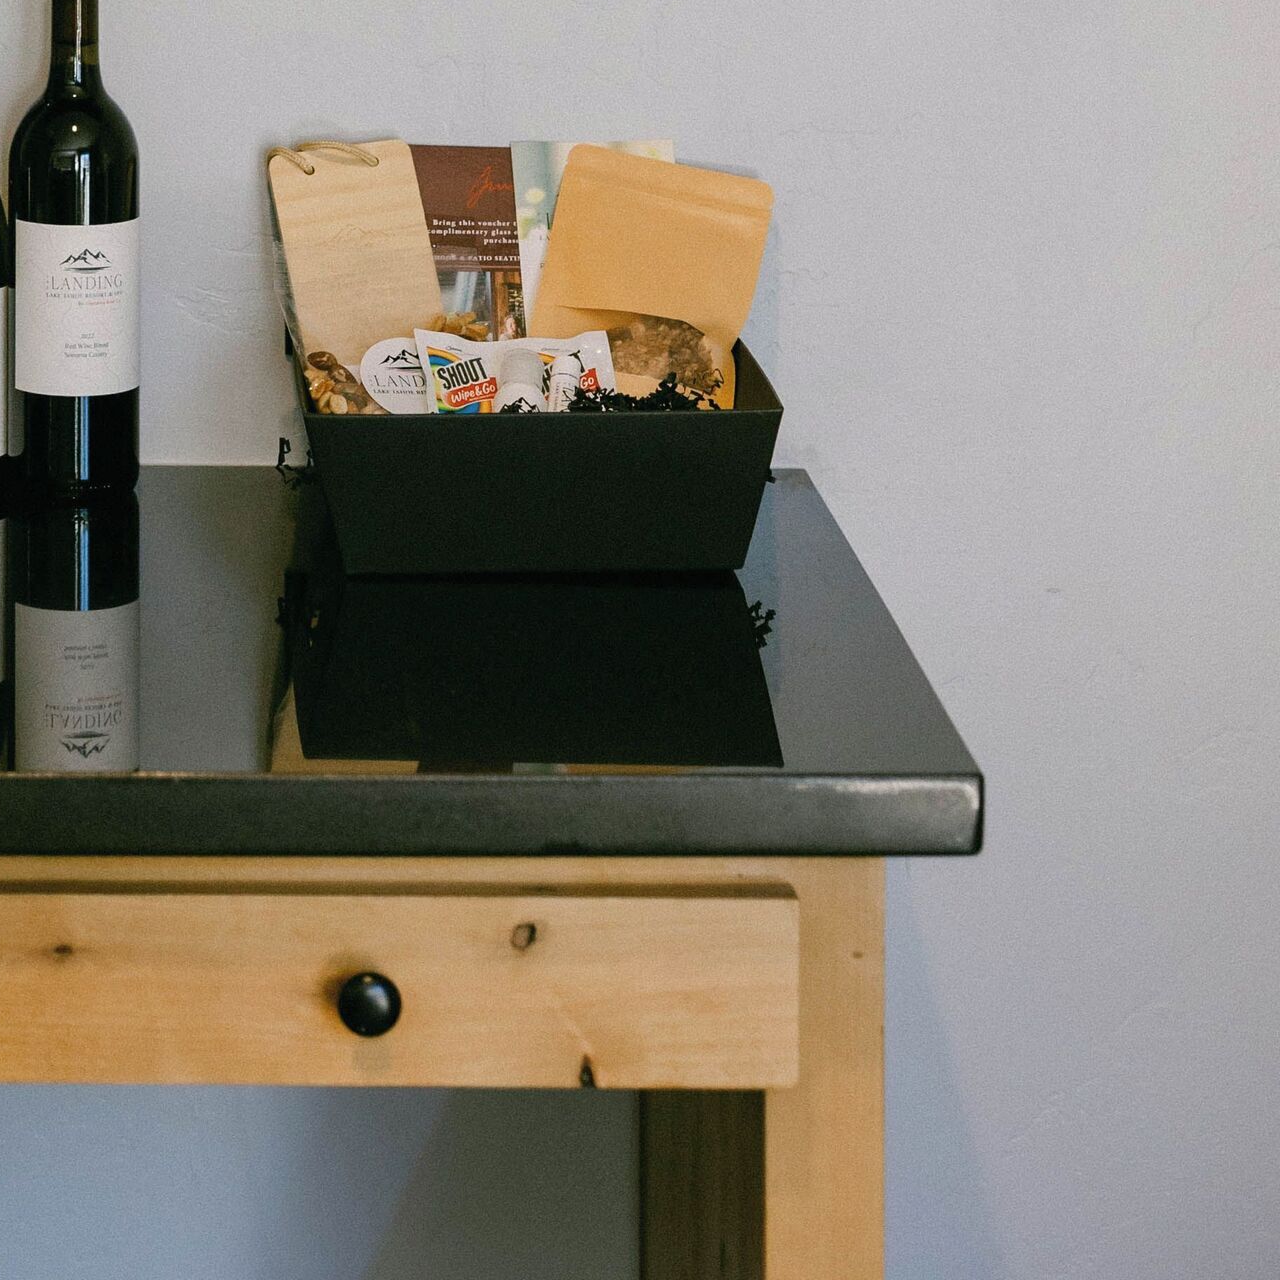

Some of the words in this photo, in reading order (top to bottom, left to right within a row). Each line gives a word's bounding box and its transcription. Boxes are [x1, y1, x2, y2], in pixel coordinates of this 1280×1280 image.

[432, 219, 456, 227] Bring
[491, 228, 511, 237] glass
[51, 274, 122, 290] LANDING
[436, 357, 488, 390] SHOUT
[373, 375, 425, 388] LAND
